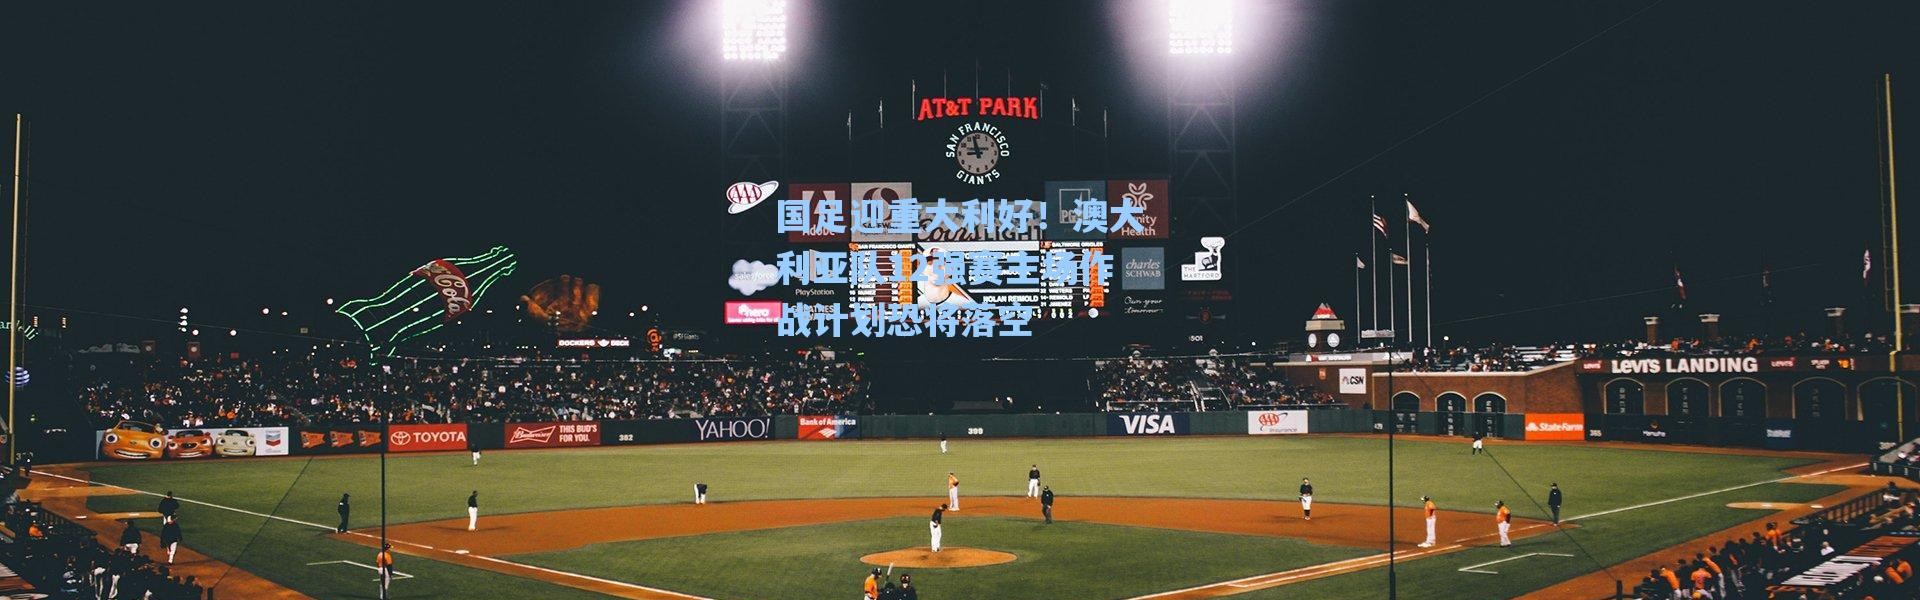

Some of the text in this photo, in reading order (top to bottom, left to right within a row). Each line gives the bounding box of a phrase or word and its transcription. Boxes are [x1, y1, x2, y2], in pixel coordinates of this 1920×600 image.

[918, 97, 1038, 120] AT&T PARK
[945, 122, 1010, 158] SAN FRANCISCO
[956, 169, 1000, 185] GIANTS
[1125, 259, 1160, 269] charles
[1125, 270, 1162, 278] SCHWAB
[795, 288, 835, 297] PlayStation
[1665, 357, 1758, 373] LANDING
[1349, 376, 1364, 385] CSN
[800, 418, 856, 426] Bank of America
[1118, 414, 1176, 434] VISA
[559, 424, 598, 434] THIS BUD'S
[695, 418, 771, 440] YAHOO!
[413, 431, 467, 443] TOYOTA
[559, 434, 590, 442] FOR YOU.
